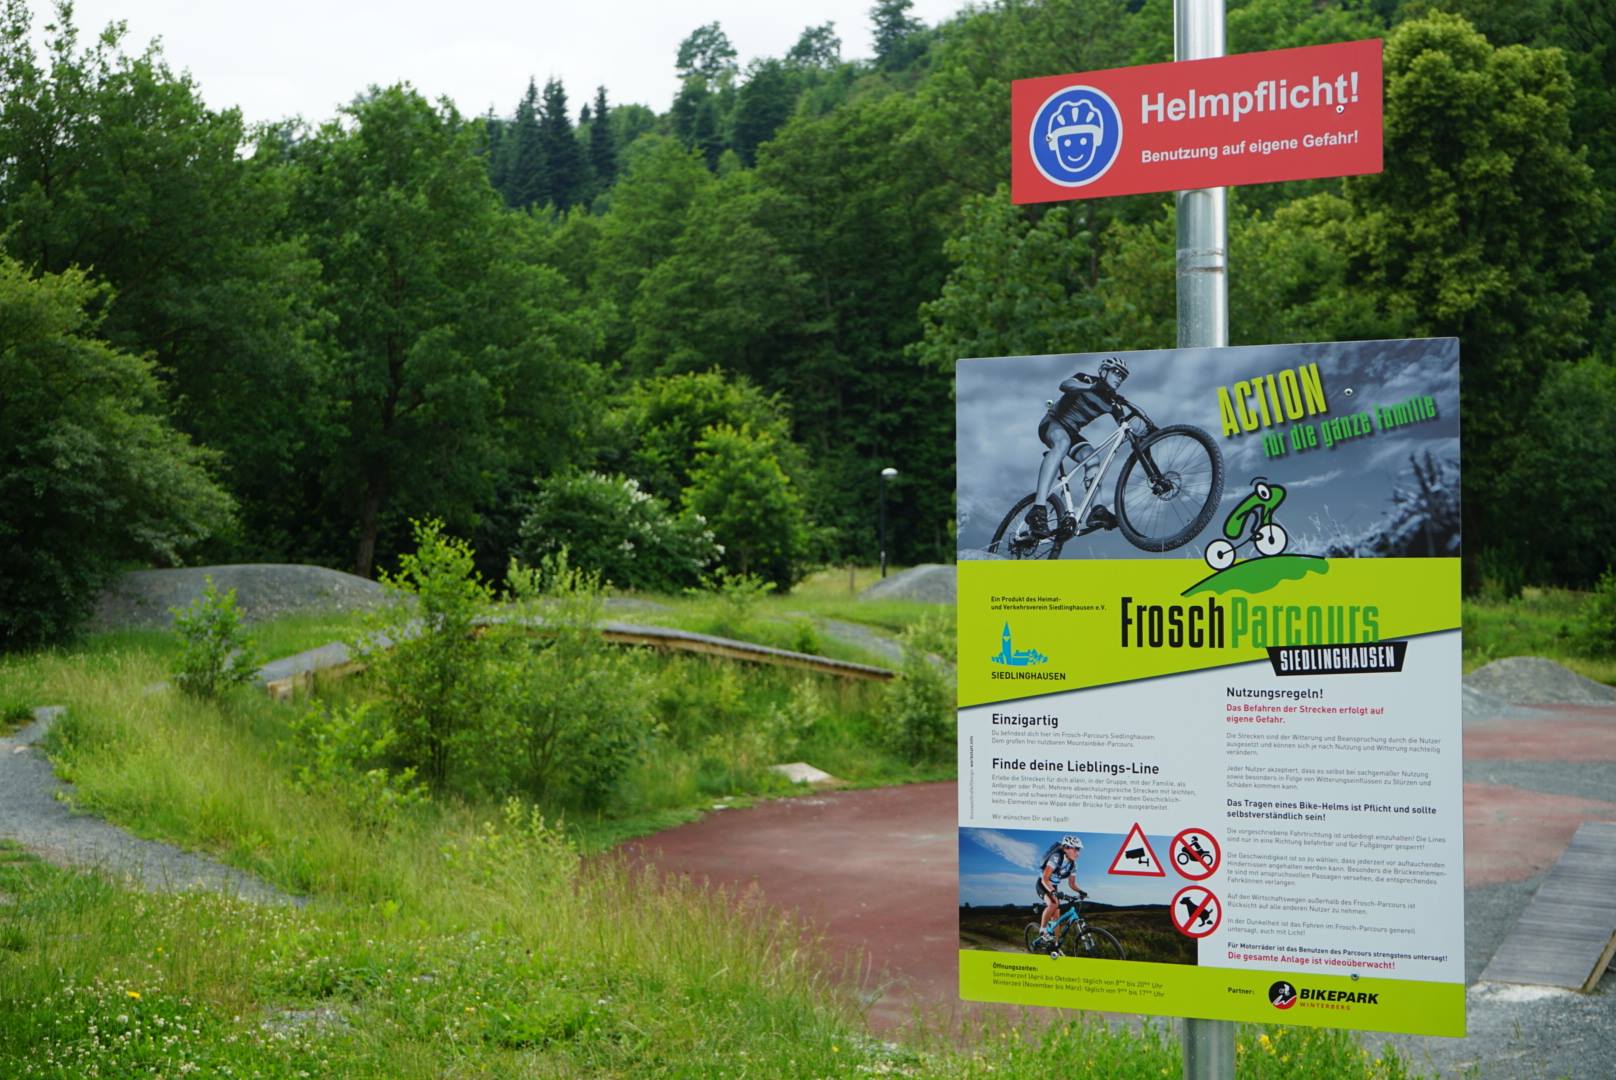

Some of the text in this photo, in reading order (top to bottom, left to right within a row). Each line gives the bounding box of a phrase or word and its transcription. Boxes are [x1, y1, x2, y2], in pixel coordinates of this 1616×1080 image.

[1141, 71, 1359, 123] Helmpflicht!
[1141, 130, 1359, 163] Benutzung auf eigene Gefahr!
[1216, 362, 1327, 437] ACTION
[1262, 395, 1437, 457] für die ganze Familie
[1048, 604, 1094, 612] Siedlinghausen
[1280, 646, 1395, 672] SIEDLINGHAUSEN
[991, 671, 1066, 681] SIEDLINGHAUSEN
[1226, 688, 1324, 701] Nutzungsregeln!
[1226, 704, 1242, 712] Das
[1243, 705, 1281, 713] Befahren
[1299, 706, 1337, 714] Strecken
[1339, 707, 1368, 717] erfolgt
[992, 714, 1059, 729] Einzigartig
[1226, 715, 1254, 724] eigene
[992, 759, 1160, 777] Finde deine Lieblings-Line
[1226, 799, 1437, 815] Das Tragen eines Bike-Helms ist Pflicht und sollte
[1226, 810, 1326, 821] selbstverständlich sein!
[1228, 941, 1238, 949] Für
[1240, 942, 1275, 951] Motorräder
[1277, 944, 1285, 952] ist
[1298, 946, 1328, 954] Benutzen
[1342, 948, 1372, 957] Parcours
[1373, 950, 1412, 961] strengstens
[1413, 953, 1448, 964] untersagt!
[992, 962, 1039, 974] Öffnungszeiten:
[1228, 952, 1396, 970] Die gesamte Anlage ist videoüberwacht!
[1228, 987, 1379, 1004] Partner: BIKEPARK
[1300, 1002, 1350, 1011] WINTERBERG
